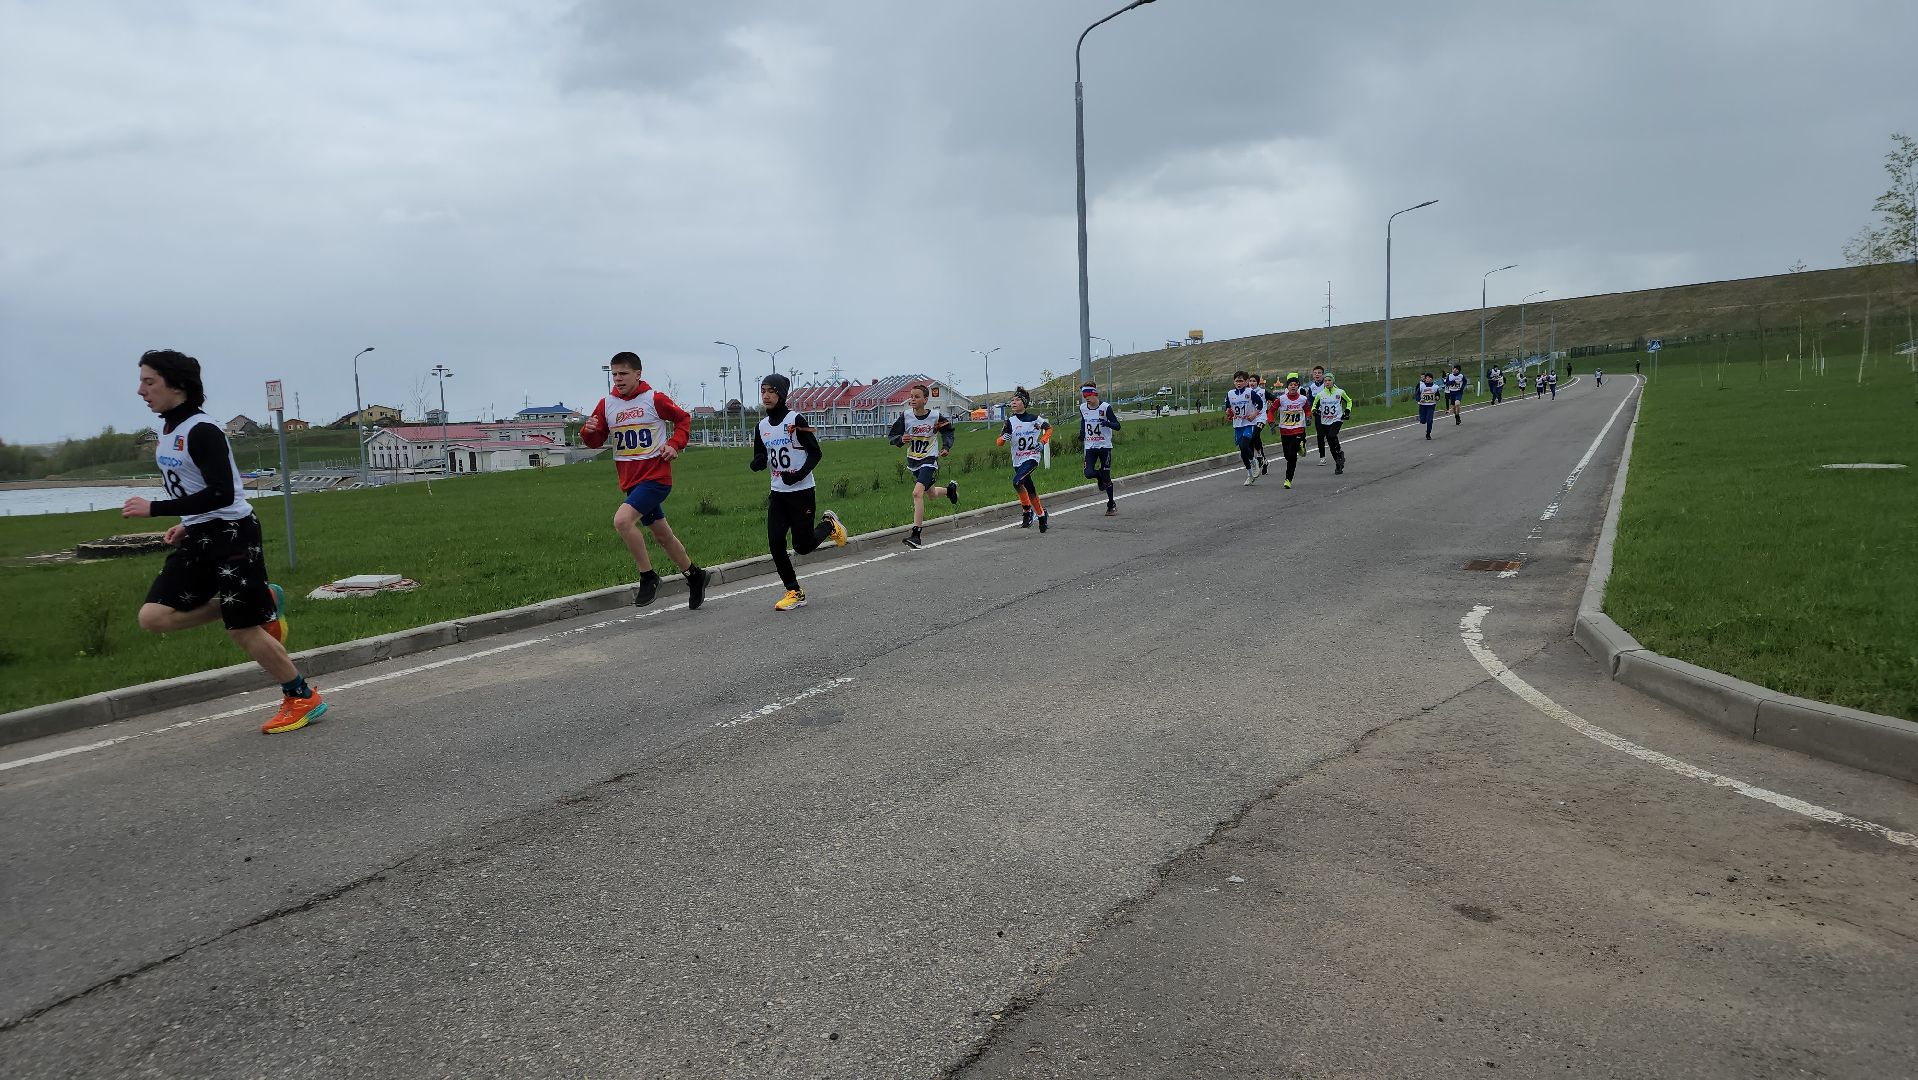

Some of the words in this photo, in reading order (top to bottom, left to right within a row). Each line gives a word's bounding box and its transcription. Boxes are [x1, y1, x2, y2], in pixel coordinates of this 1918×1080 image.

[1234, 403, 1246, 416] 91
[1323, 405, 1336, 416] 83
[1086, 423, 1101, 437] 84
[614, 428, 653, 451] 209
[911, 439, 930, 454] 102
[1018, 435, 1035, 451] 92
[770, 446, 791, 469] 86
